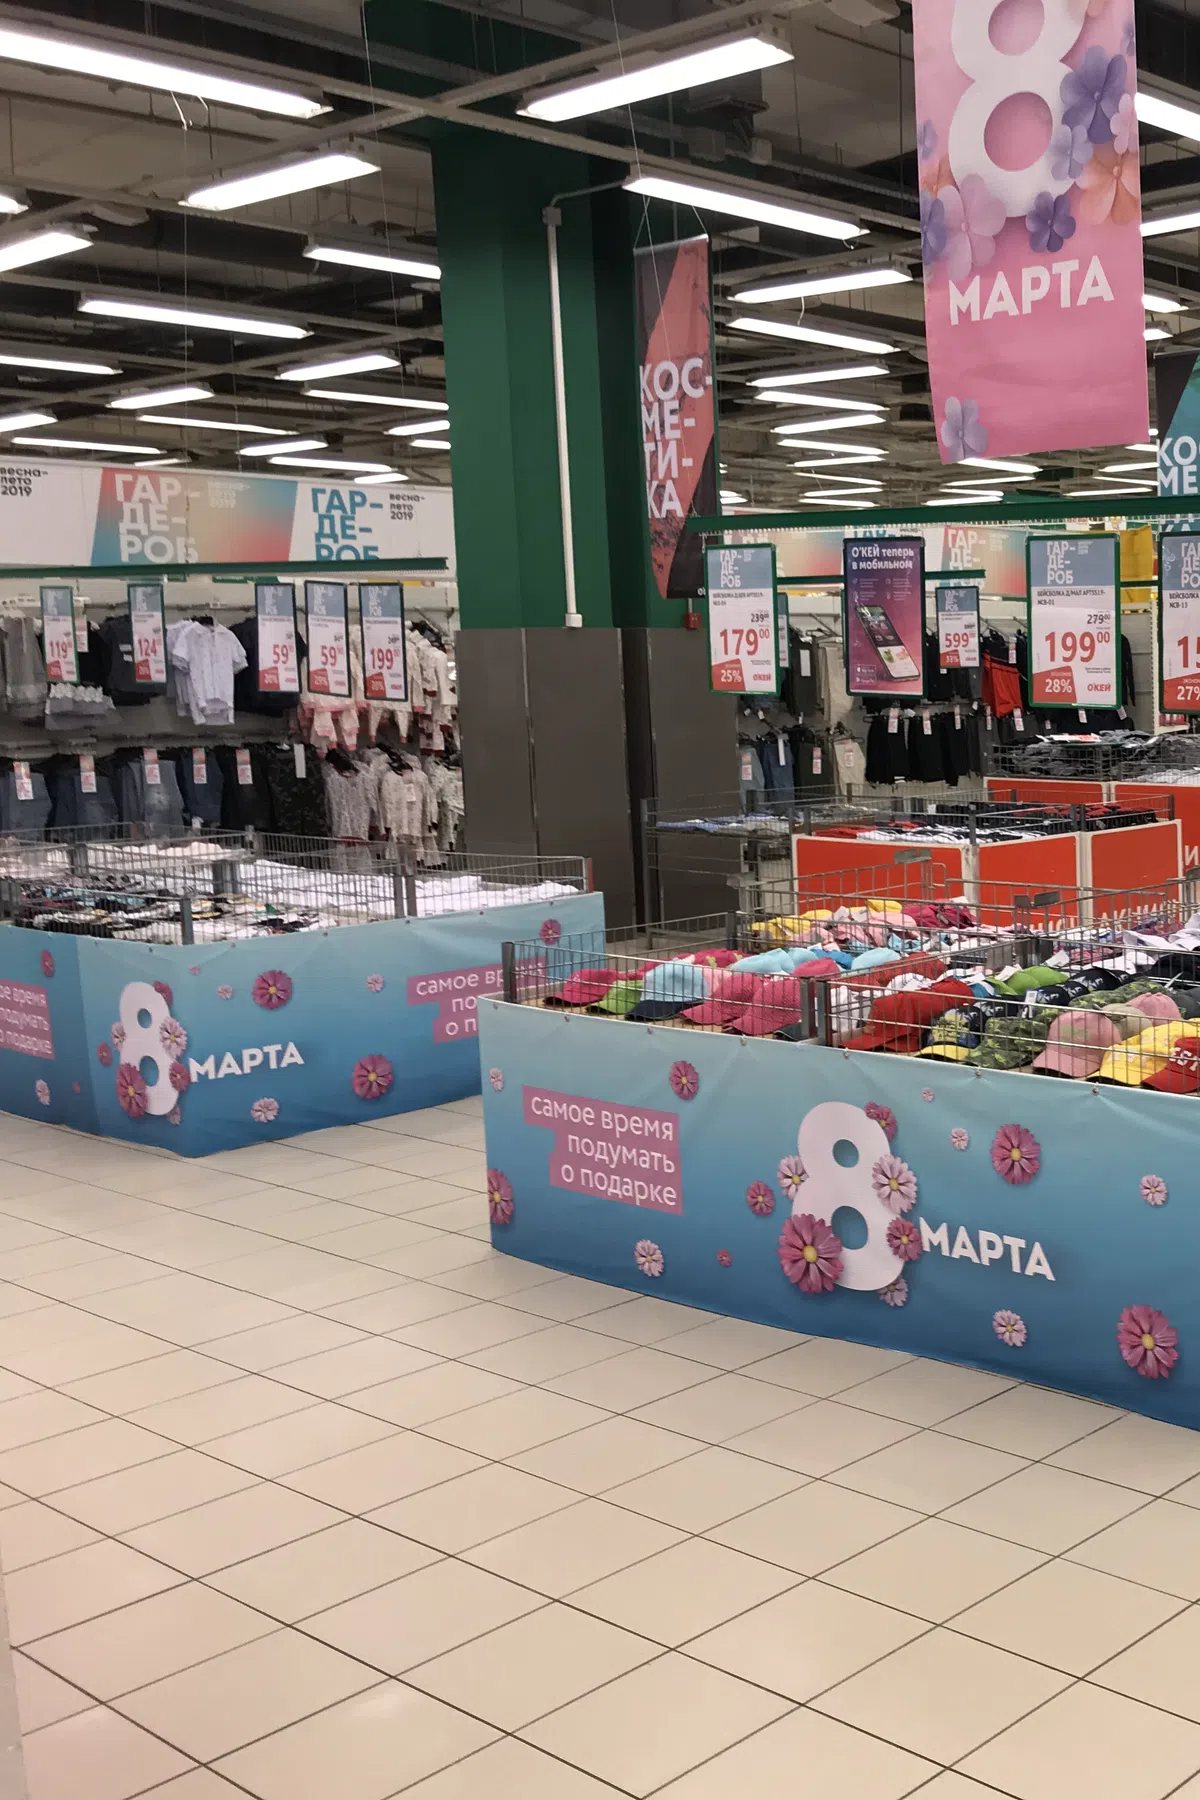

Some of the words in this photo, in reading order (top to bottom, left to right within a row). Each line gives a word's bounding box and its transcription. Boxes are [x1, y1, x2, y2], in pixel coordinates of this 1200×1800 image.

[948, 0, 1086, 217] 8
[948, 255, 1114, 325] МАРТА
[639, 357, 712, 401] КОС-
[640, 400, 695, 440] МЕ-
[643, 439, 693, 480] ТИ-
[1, 486, 32, 496] 2019
[115, 473, 200, 504] ГАР-
[646, 480, 684, 519] КА
[312, 488, 383, 515] ГАР-
[119, 502, 186, 535] ДЕ-
[390, 511, 413, 520] 2019
[315, 513, 372, 544] ДЕ-
[947, 529, 986, 548] ГАР-
[120, 534, 199, 564] РОБ
[882, 549, 914, 558] теперь
[1047, 541, 1076, 555] ГАР-
[852, 561, 857, 570] в
[859, 559, 912, 570] мобильном
[1048, 555, 1070, 570] ДЕ-
[1047, 570, 1073, 584] РОБ
[1087, 614, 1104, 624] 279
[49, 640, 67, 658] 119
[720, 629, 759, 656] 179
[759, 629, 770, 639] 00
[945, 633, 969, 648] 599
[1045, 631, 1095, 663] 199
[1097, 631, 1110, 643] 00
[272, 644, 289, 665] 59
[321, 646, 337, 667] 59
[371, 649, 394, 670] 199
[720, 670, 742, 682] 25%
[1045, 679, 1072, 693] 28%
[416, 973, 479, 996] самое
[446, 1022, 459, 1035] о
[119, 981, 181, 1116] 8
[188, 1042, 305, 1083] МАРТА
[531, 1093, 595, 1127] самое
[600, 1104, 674, 1142] время
[568, 1133, 675, 1174] подумать
[561, 1164, 575, 1182] о
[580, 1165, 677, 1207] подарке
[791, 1101, 904, 1291] 8
[918, 1216, 1056, 1281] МАРТА
